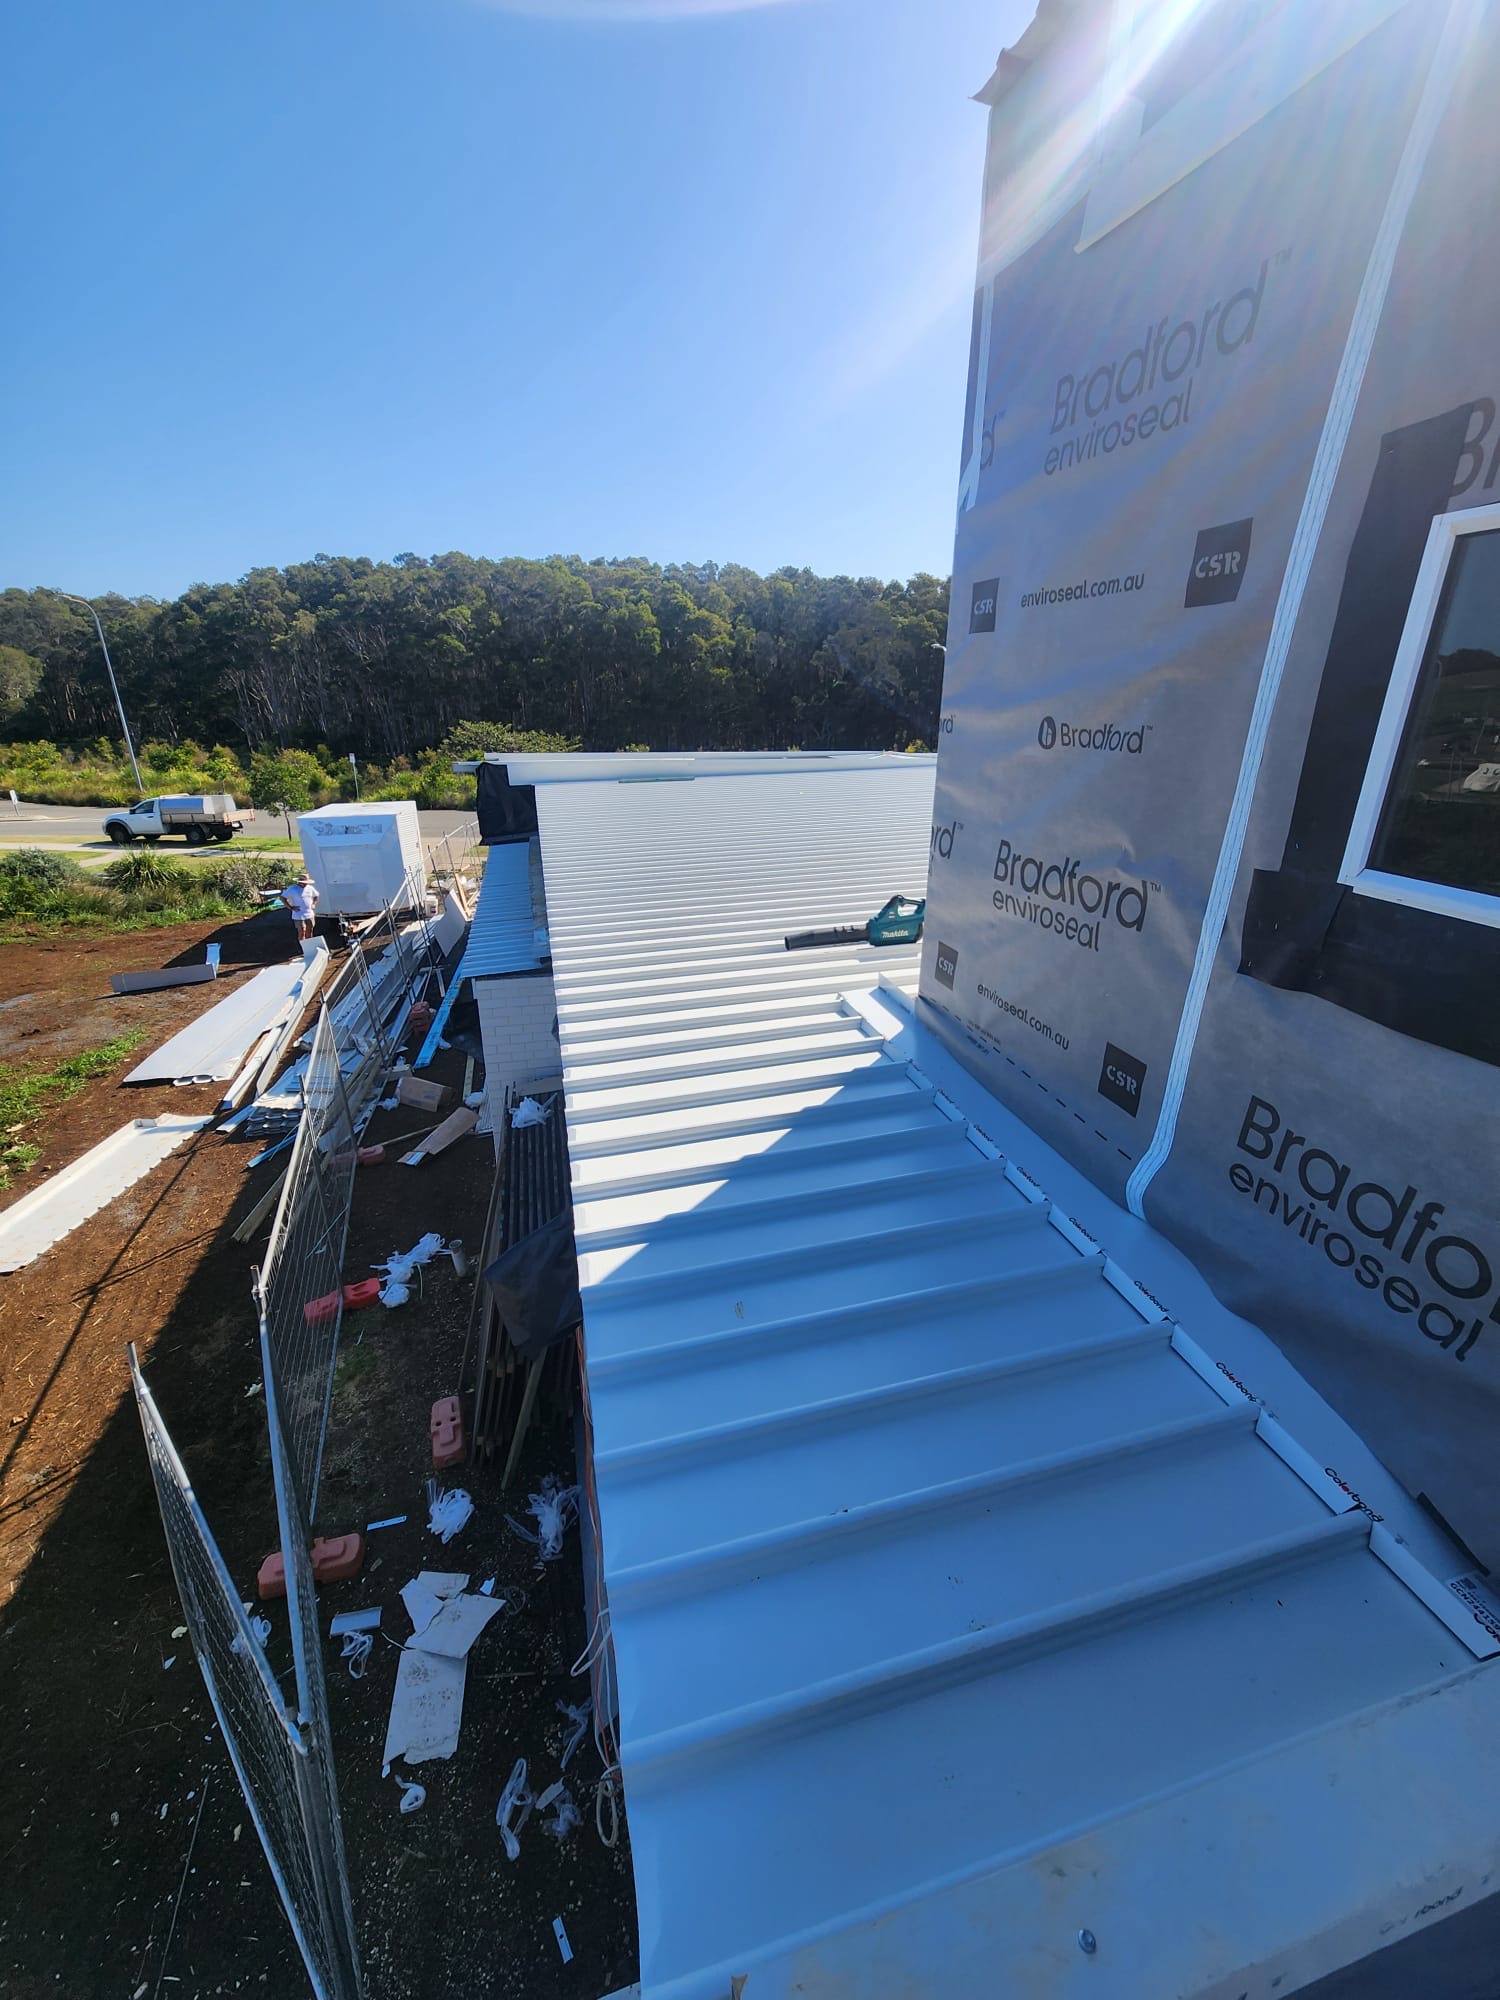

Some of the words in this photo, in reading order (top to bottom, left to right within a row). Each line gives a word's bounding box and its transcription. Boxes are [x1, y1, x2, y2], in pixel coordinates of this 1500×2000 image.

[1043, 376, 1194, 476] enviroseal
[1194, 551, 1241, 579] CSR
[973, 598, 994, 615] CSR
[1020, 573, 1145, 608] enviroseal.com.au
[992, 889, 1101, 952] enviroseal
[937, 956, 955, 976] CSR
[976, 983, 1070, 1050] enviroseal.com.au
[1106, 1065, 1138, 1096] CSR
[1237, 1094, 1500, 1325] Bradfo
[1228, 1162, 1485, 1363] enviroseal
